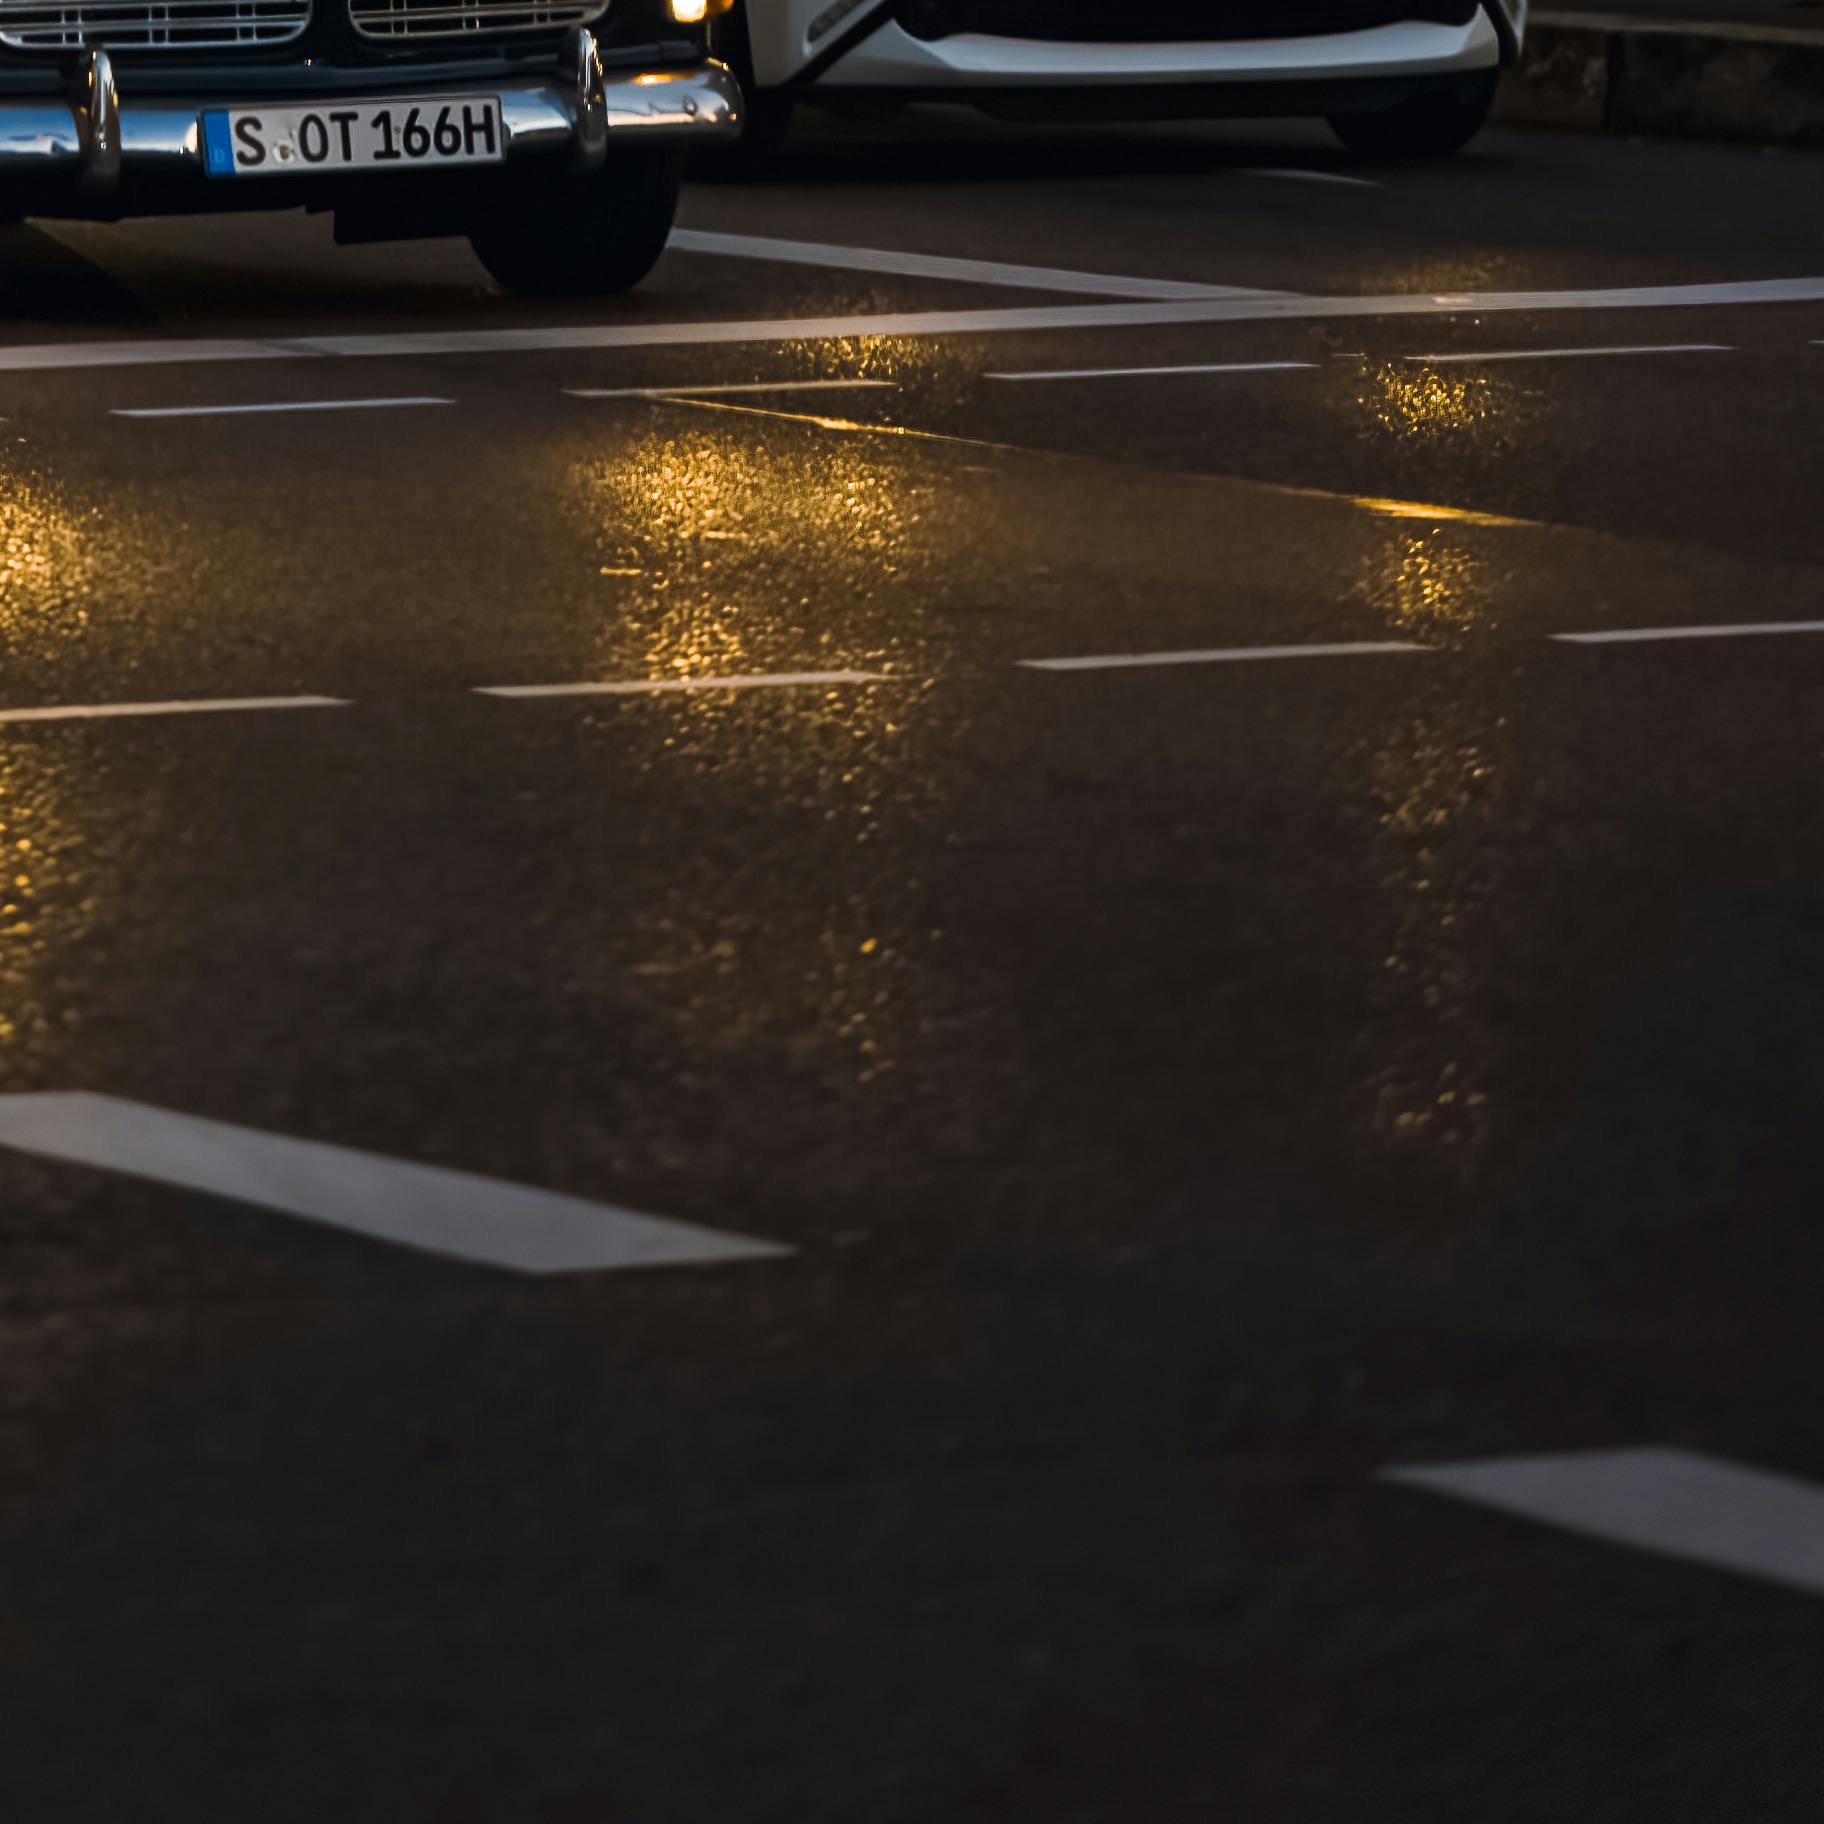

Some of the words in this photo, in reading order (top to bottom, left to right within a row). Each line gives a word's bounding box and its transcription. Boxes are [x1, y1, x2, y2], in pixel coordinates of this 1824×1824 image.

[234, 115, 268, 167] S
[298, 111, 360, 163] OT
[370, 104, 498, 160] 166H
